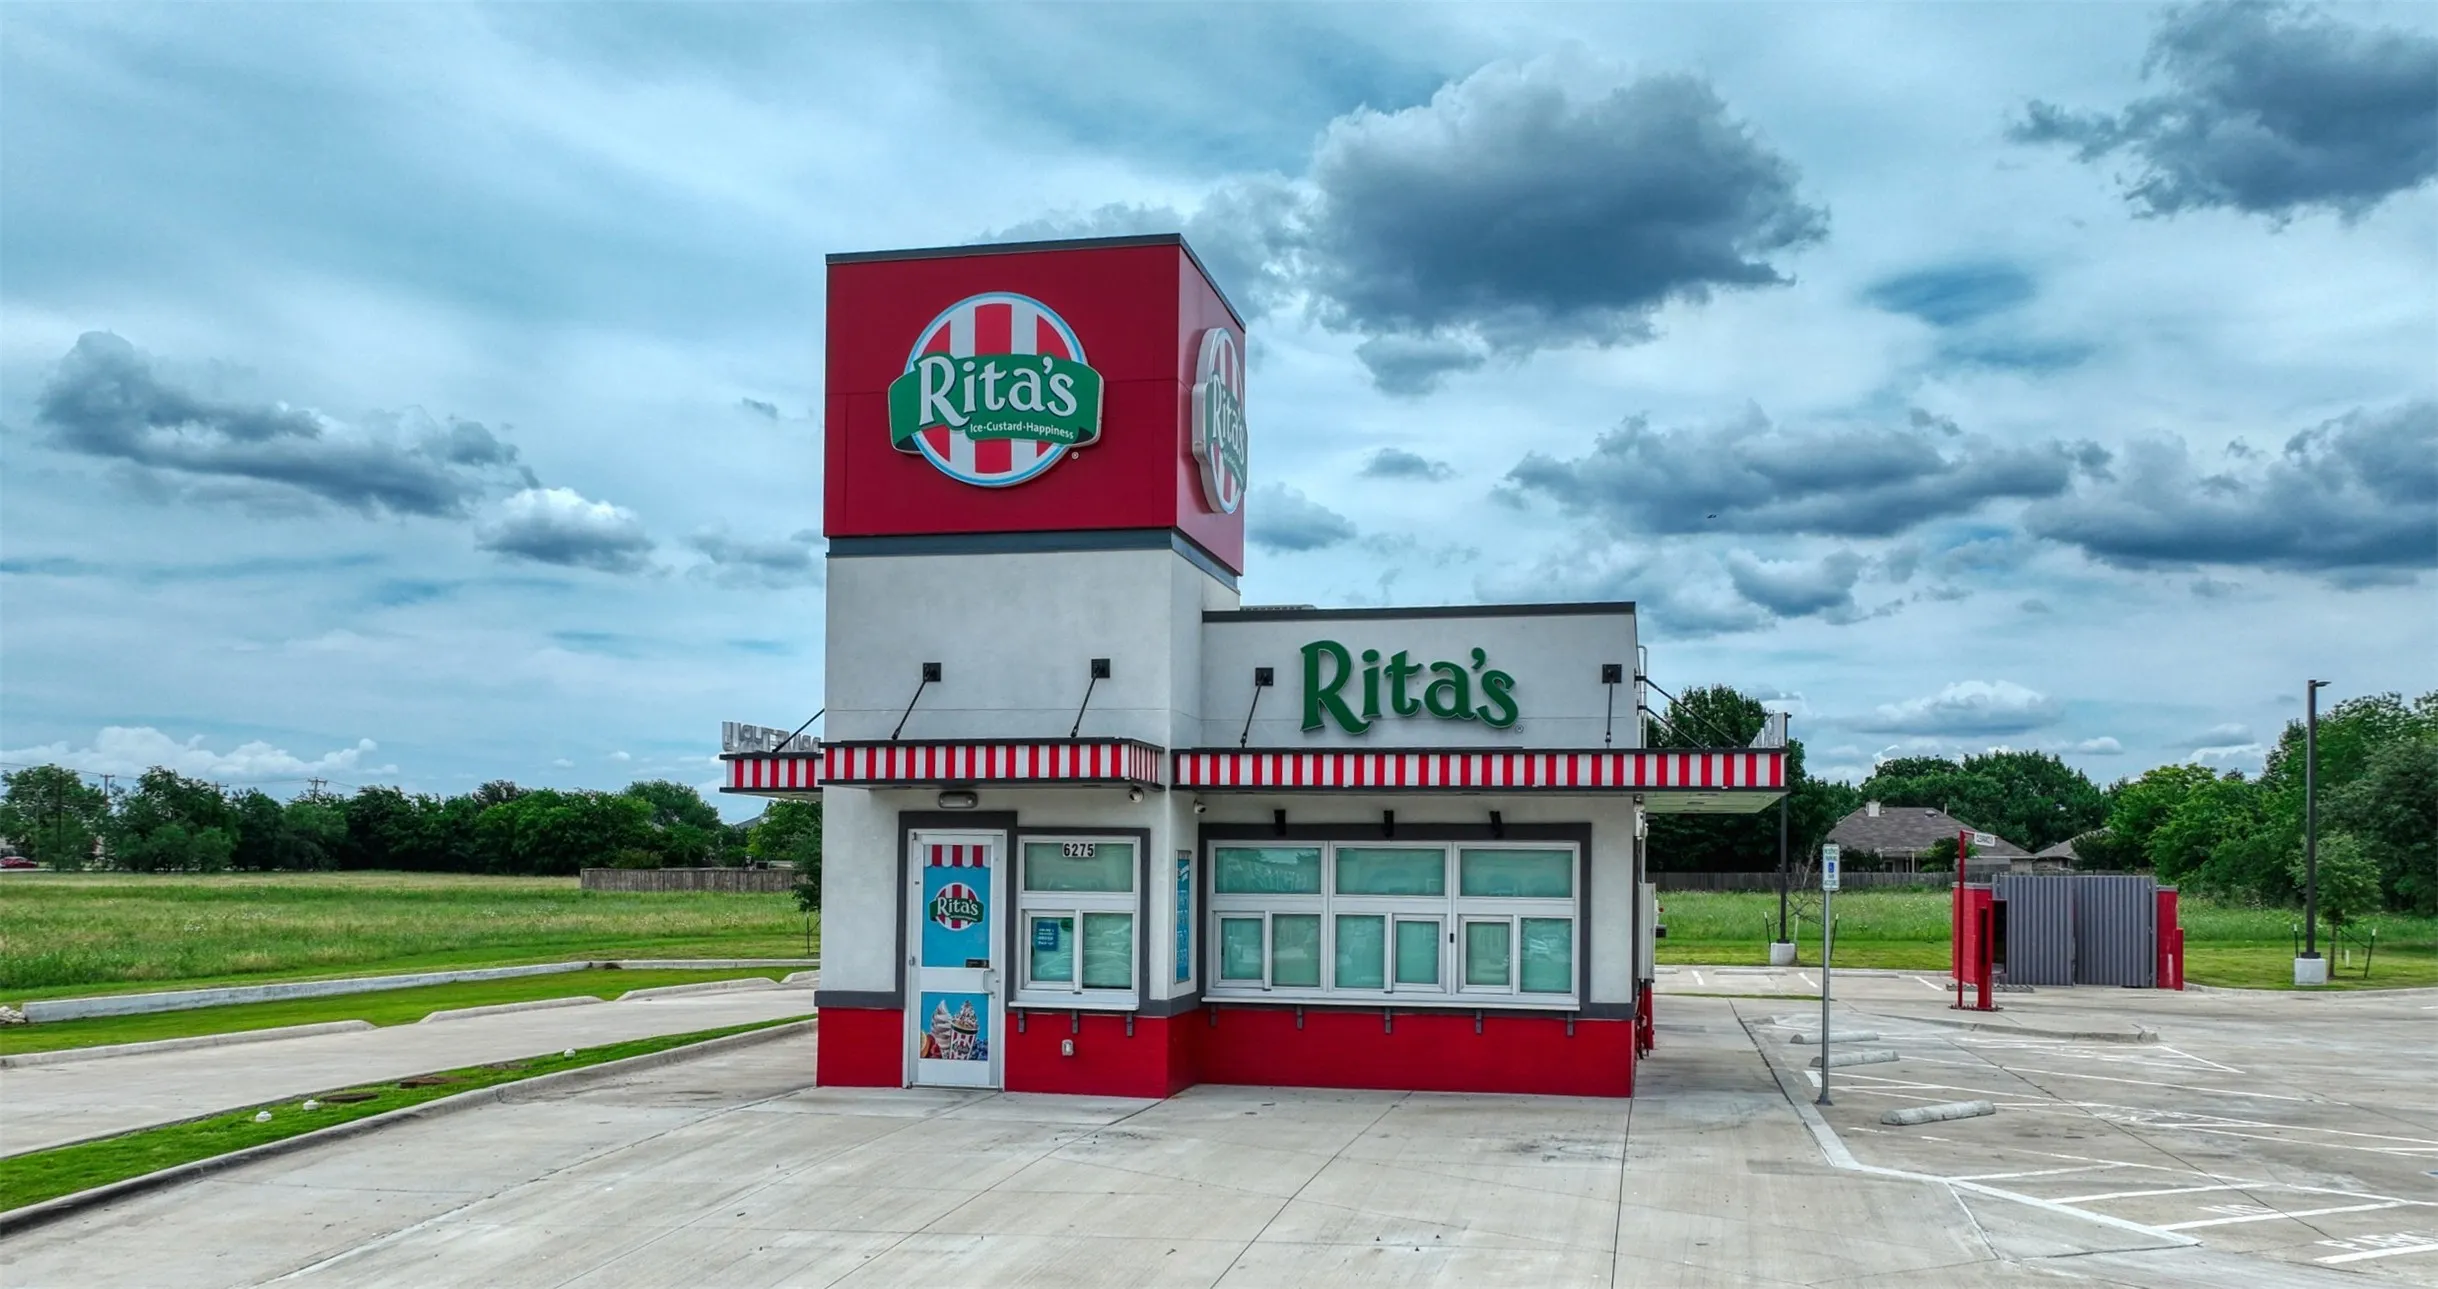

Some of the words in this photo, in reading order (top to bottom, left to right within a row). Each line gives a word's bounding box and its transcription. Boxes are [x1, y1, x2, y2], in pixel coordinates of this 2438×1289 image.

[918, 356, 1077, 427] Rita's
[1212, 374, 1245, 466] Rita's
[1300, 639, 1519, 735] Rita's
[1063, 842, 1095, 857] 6275
[937, 896, 979, 916] Rita's
